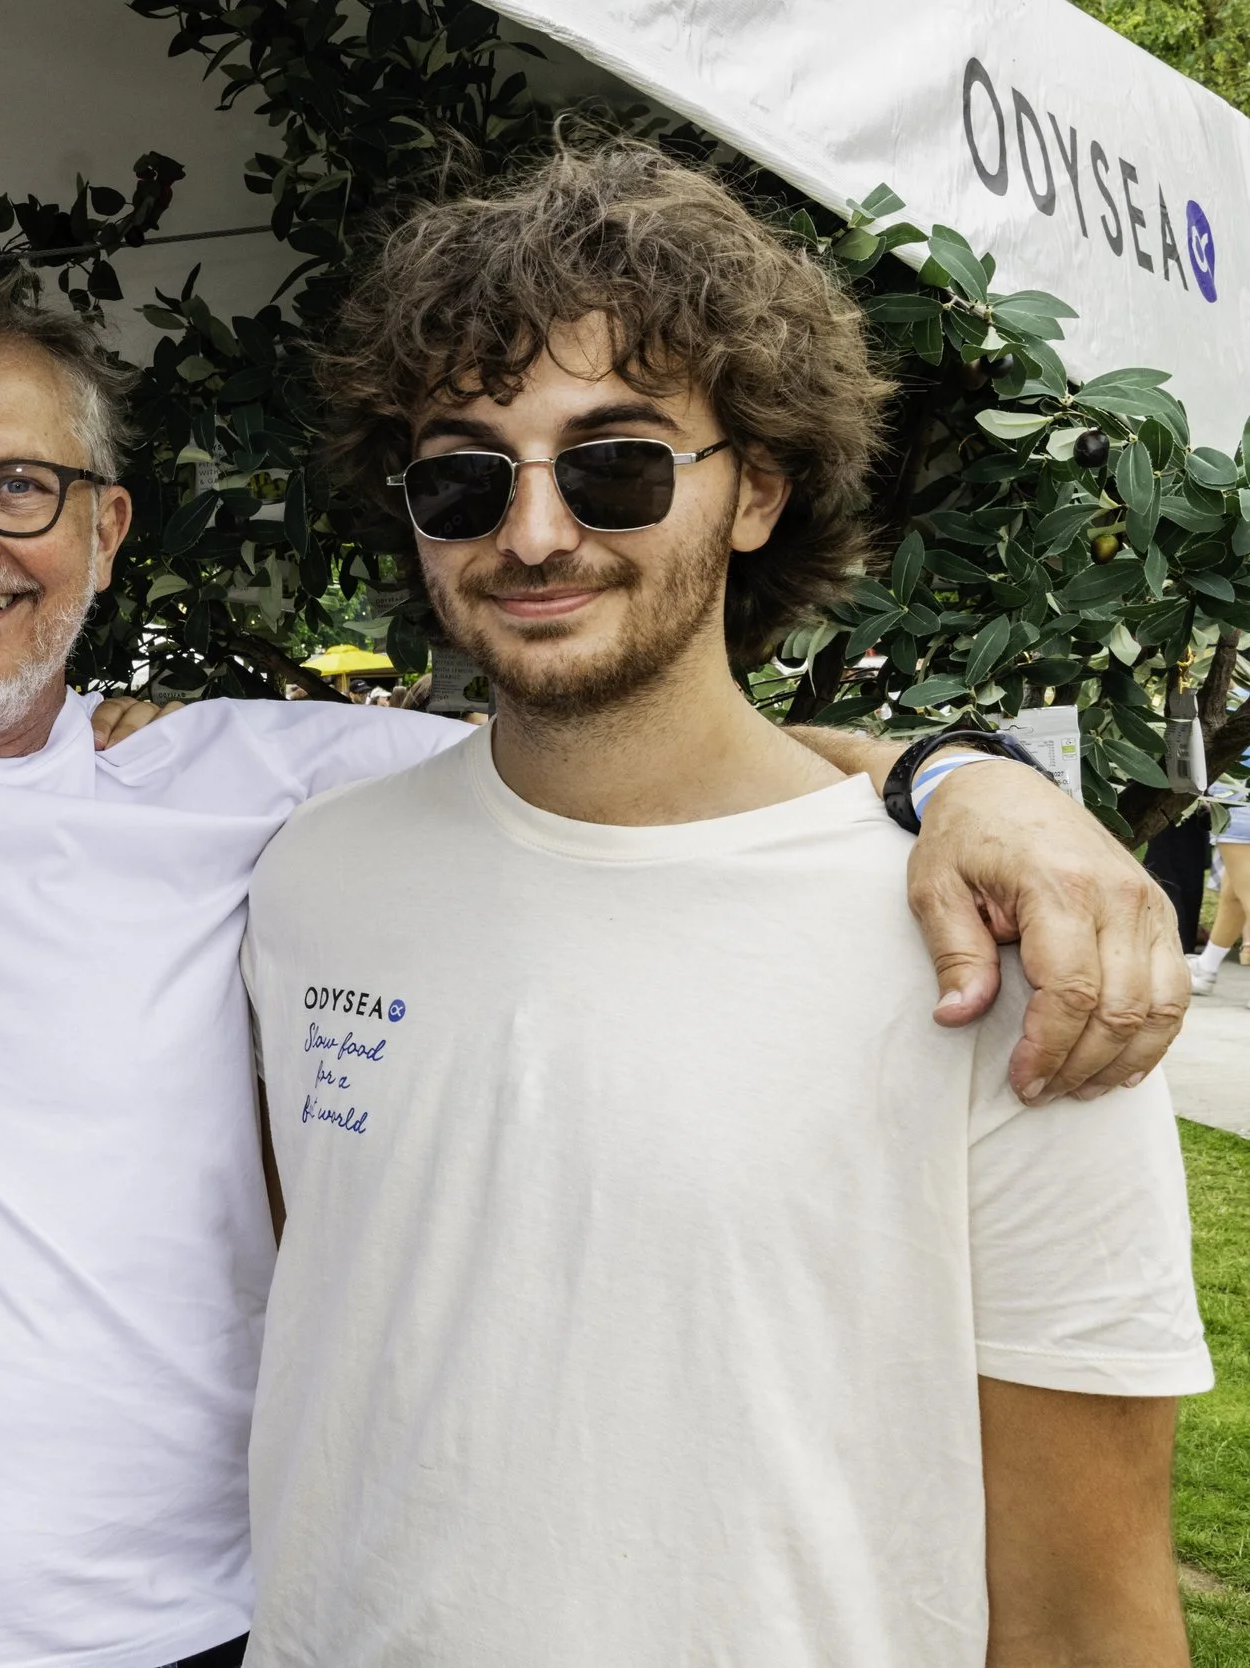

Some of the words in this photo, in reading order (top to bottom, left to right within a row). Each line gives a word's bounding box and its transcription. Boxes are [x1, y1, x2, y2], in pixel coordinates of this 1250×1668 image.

[963, 57, 1188, 291] ODYSEA
[304, 986, 383, 1020] ODYSEA
[337, 1031, 387, 1061] food
[318, 1106, 369, 1134] world
